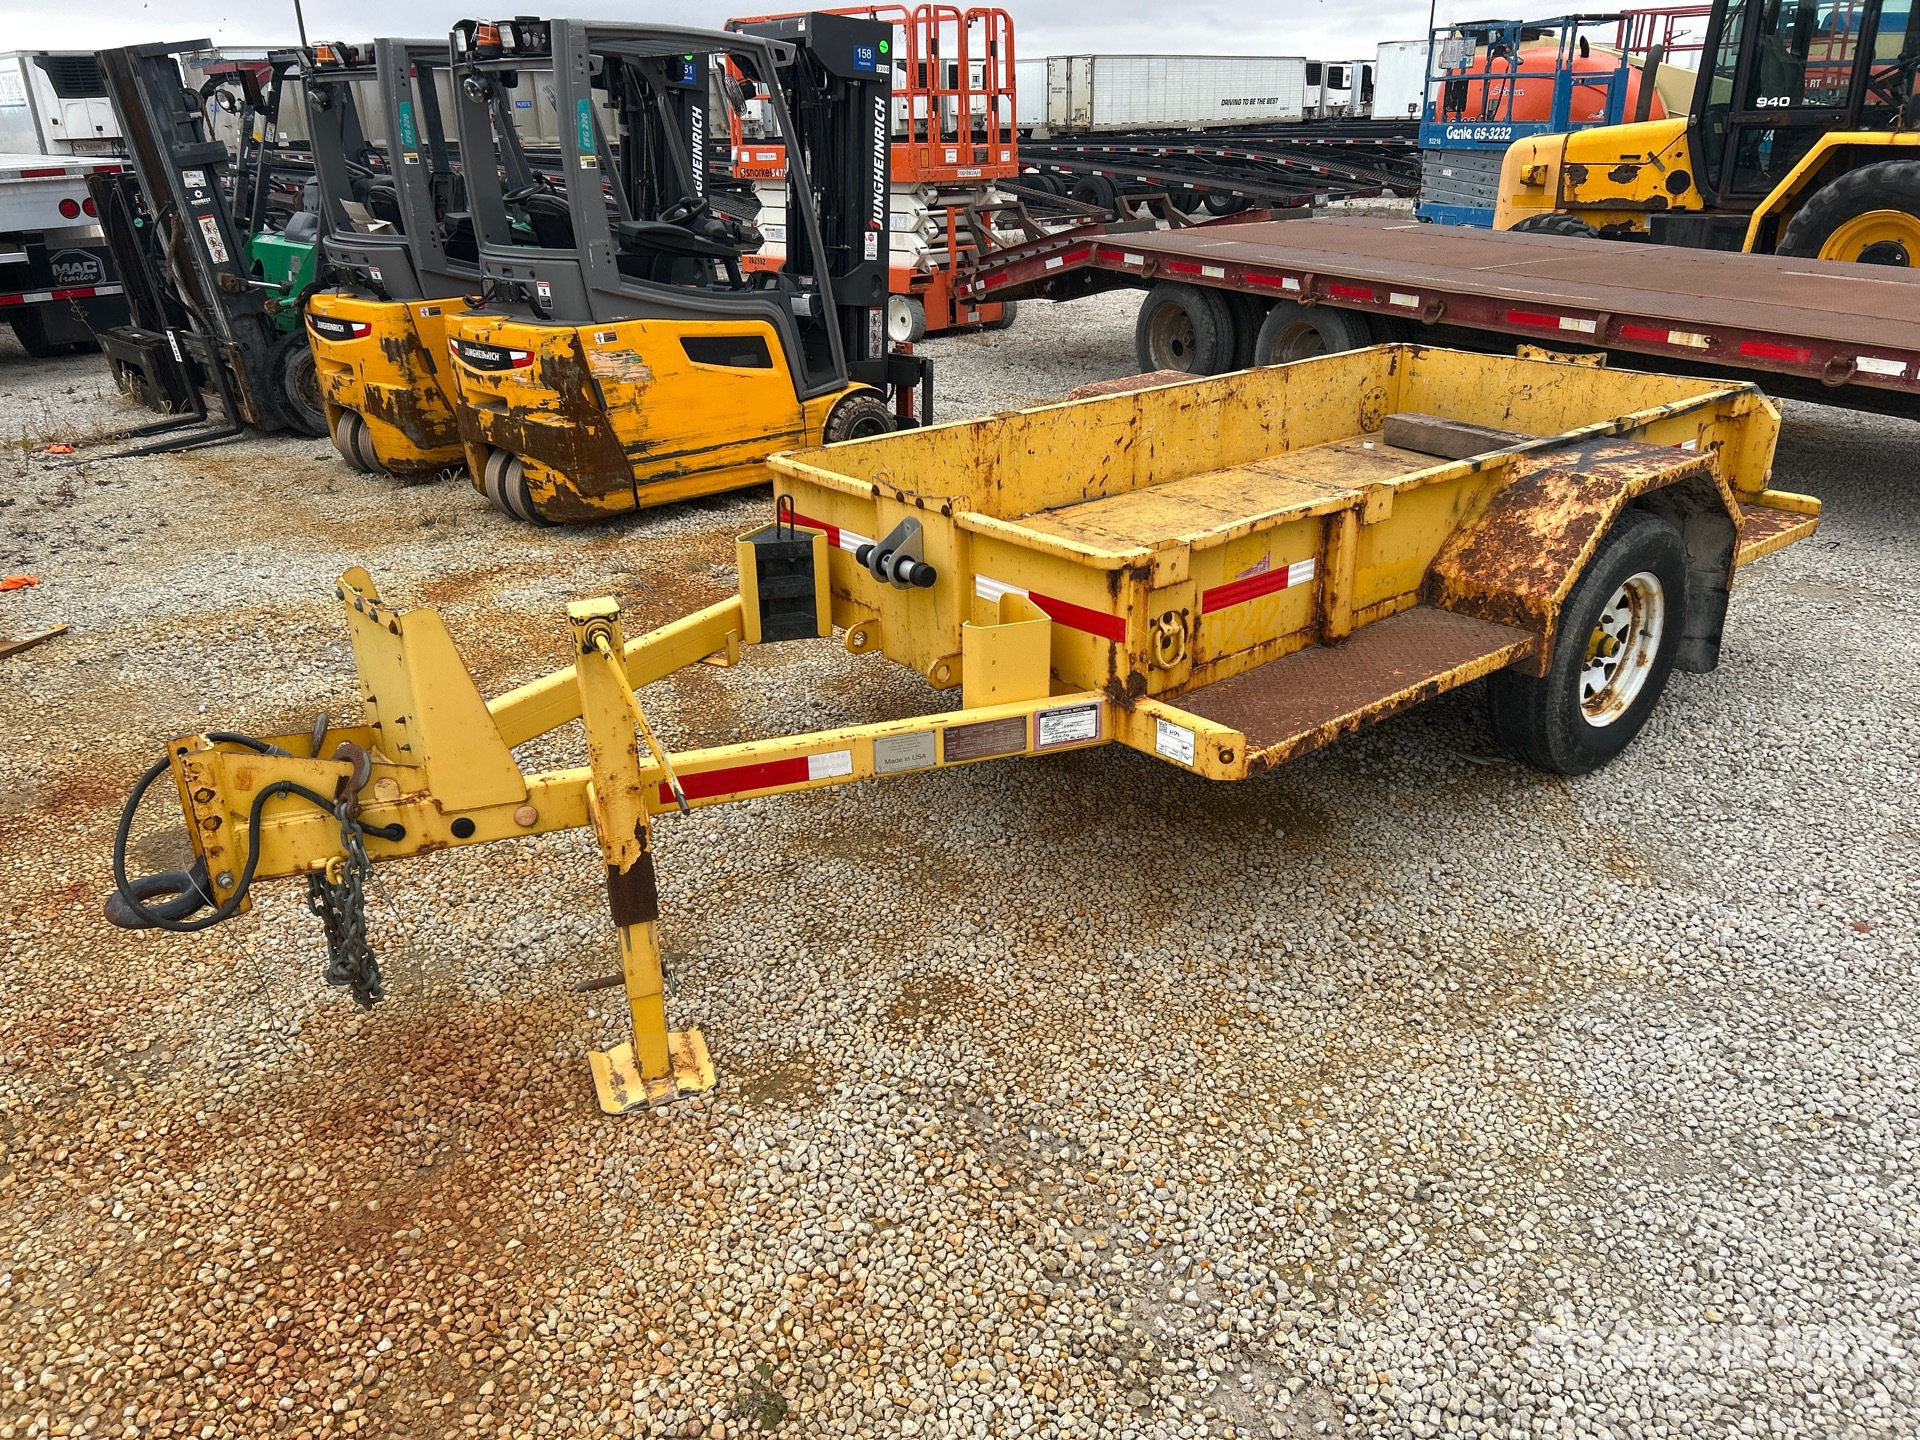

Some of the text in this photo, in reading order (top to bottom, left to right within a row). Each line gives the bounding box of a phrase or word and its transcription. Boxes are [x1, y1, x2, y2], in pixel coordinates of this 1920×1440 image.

[856, 47, 872, 59] 158
[1810, 79, 1822, 88] RT
[1220, 98, 1242, 106] DRIVING
[1256, 97, 1266, 105] THE
[1755, 96, 1791, 108] 940
[402, 113, 413, 144] EFG 220
[580, 112, 591, 147] EFG 220
[1446, 125, 1512, 140] Genie GS-3232
[691, 105, 703, 198] GHEINRICH
[868, 96, 886, 231] JUNGHEINRICH
[745, 167, 772, 178] snorkel
[51, 261, 98, 276] MAC
[56, 271, 96, 283] Trailer
[316, 319, 345, 333] JUNGHEINRICH
[464, 345, 500, 362] JUNGHEINRICH
[884, 757, 903, 765] Made
[912, 753, 927, 761] USA
